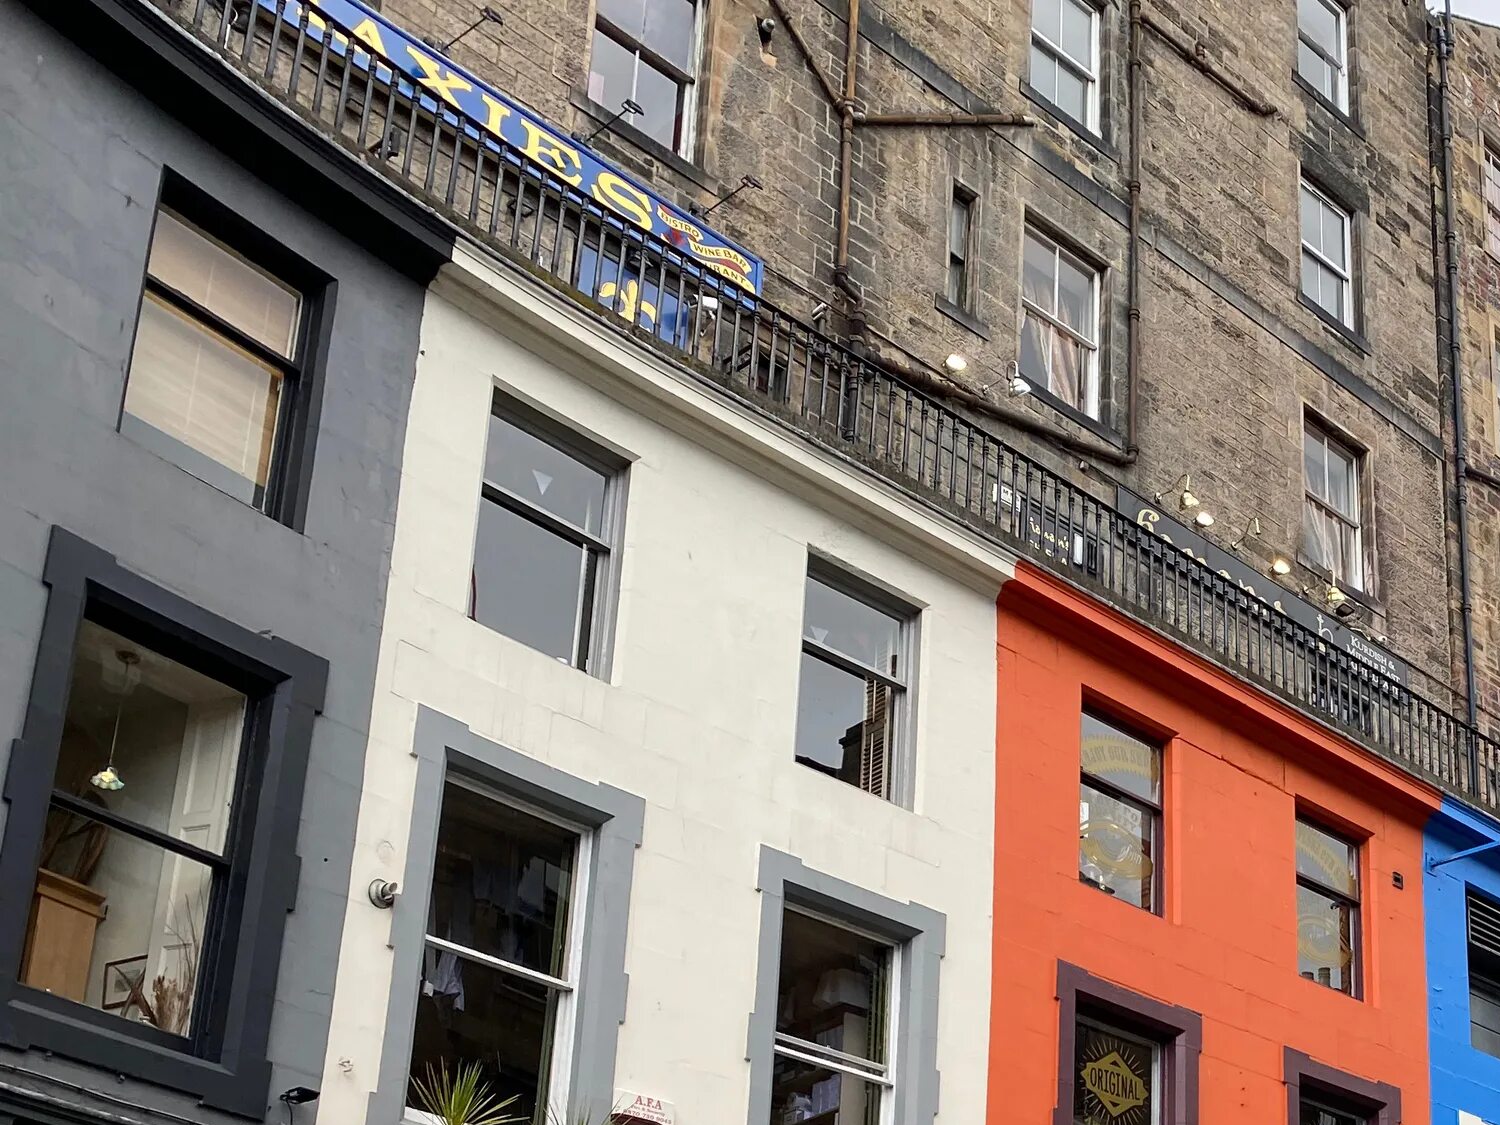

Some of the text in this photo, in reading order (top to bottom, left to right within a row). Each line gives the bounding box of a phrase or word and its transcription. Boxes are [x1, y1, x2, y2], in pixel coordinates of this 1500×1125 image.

[297, 0, 652, 231] AXIES
[661, 211, 700, 238] BISTRO
[693, 244, 747, 268] WINE BAR
[1350, 635, 1396, 671] KURDISH &
[1090, 1067, 1140, 1100] ORIGINAL
